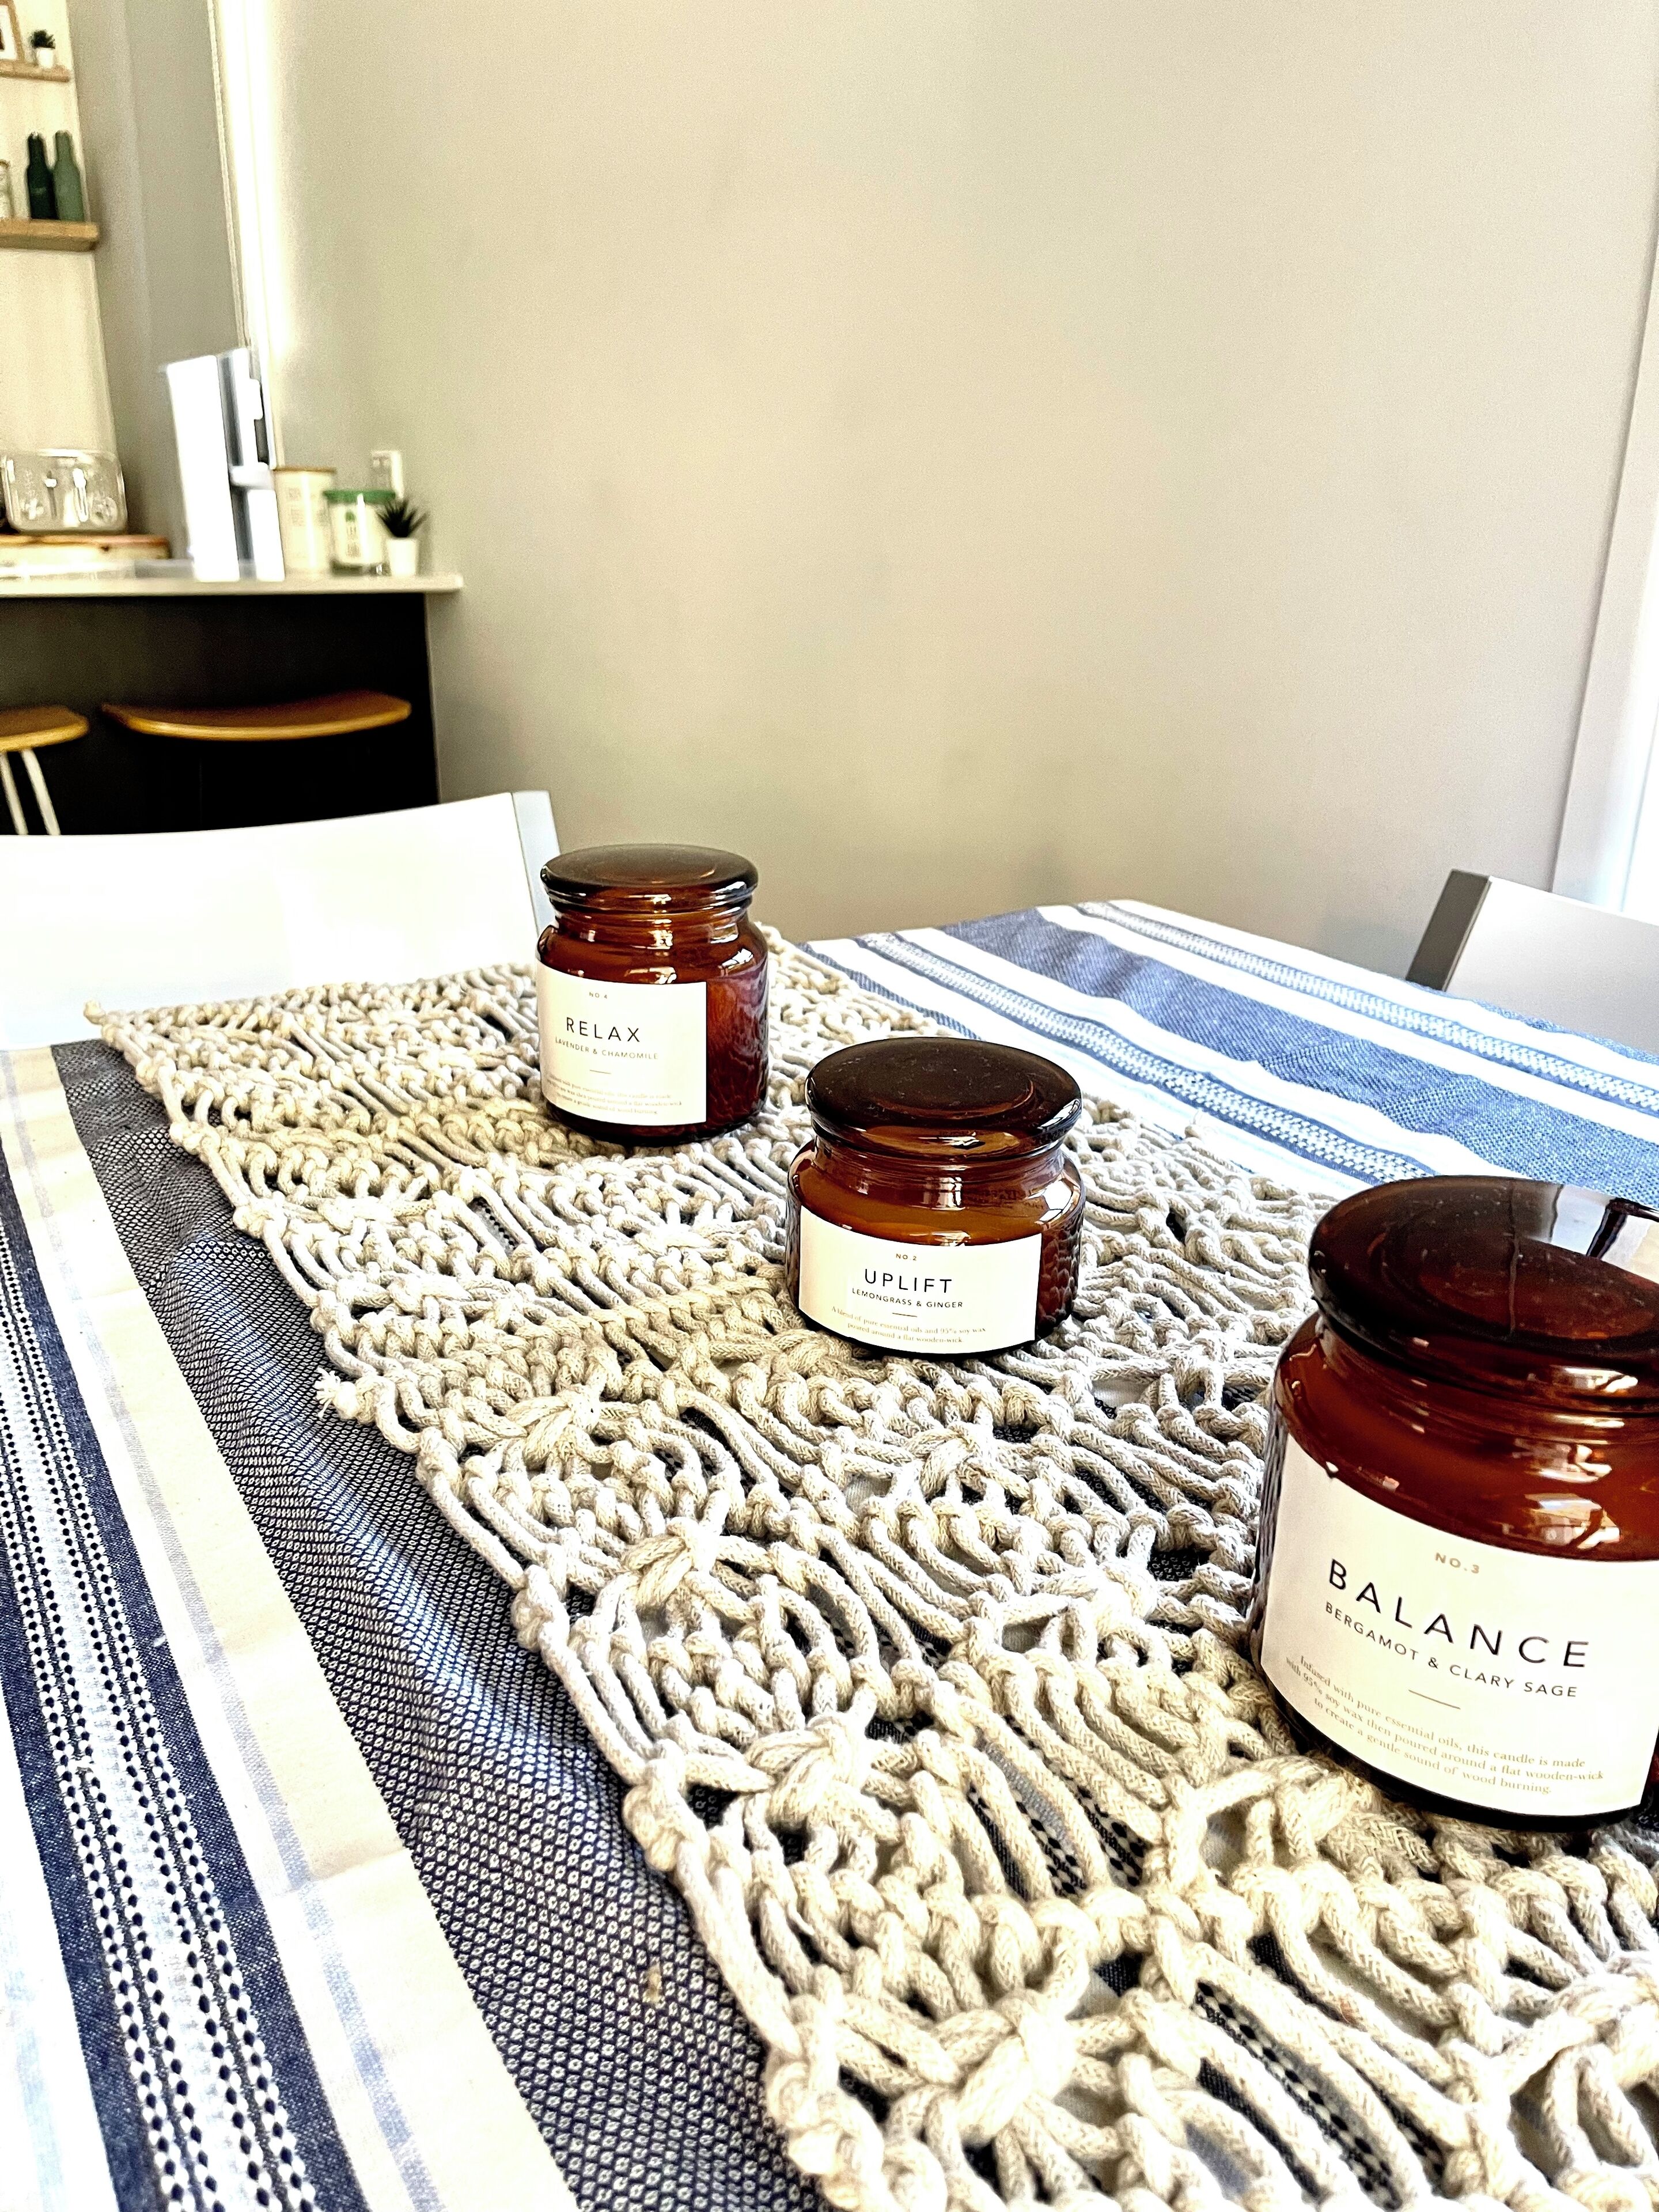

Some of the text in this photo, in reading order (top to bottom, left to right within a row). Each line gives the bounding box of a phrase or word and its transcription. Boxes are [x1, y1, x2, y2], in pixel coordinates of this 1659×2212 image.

[566, 1017, 640, 1042] RELAX
[555, 1036, 589, 1052] LAVENDER
[601, 1050, 658, 1060] CHAMOMILE
[865, 1268, 952, 1293] UPLIFT
[852, 1287, 912, 1306] LEMONGRASS
[837, 1308, 853, 1319] blend
[880, 1323, 908, 1331] essential
[871, 1330, 895, 1338] around
[1434, 1552, 1480, 1574] NO.3
[1328, 1558, 1589, 1668] BALANCE
[1325, 1600, 1578, 1698] BERGAMOT & CLARY SAGE
[1286, 1656, 1301, 1677] with
[1303, 1672, 1323, 1695] 95%
[1325, 1694, 1340, 1709] soy
[1343, 1705, 1363, 1722] wax
[1367, 1718, 1391, 1736] then
[1394, 1733, 1437, 1756] poured
[1441, 1752, 1486, 1770] around
[1502, 1764, 1521, 1775] flat
[1525, 1770, 1604, 1781] wooden-wick
[1301, 1655, 1585, 1767] Infused with pure essential oils, this candle is made
[1314, 1697, 1551, 1795] to create a gentle sound of wood burning.
